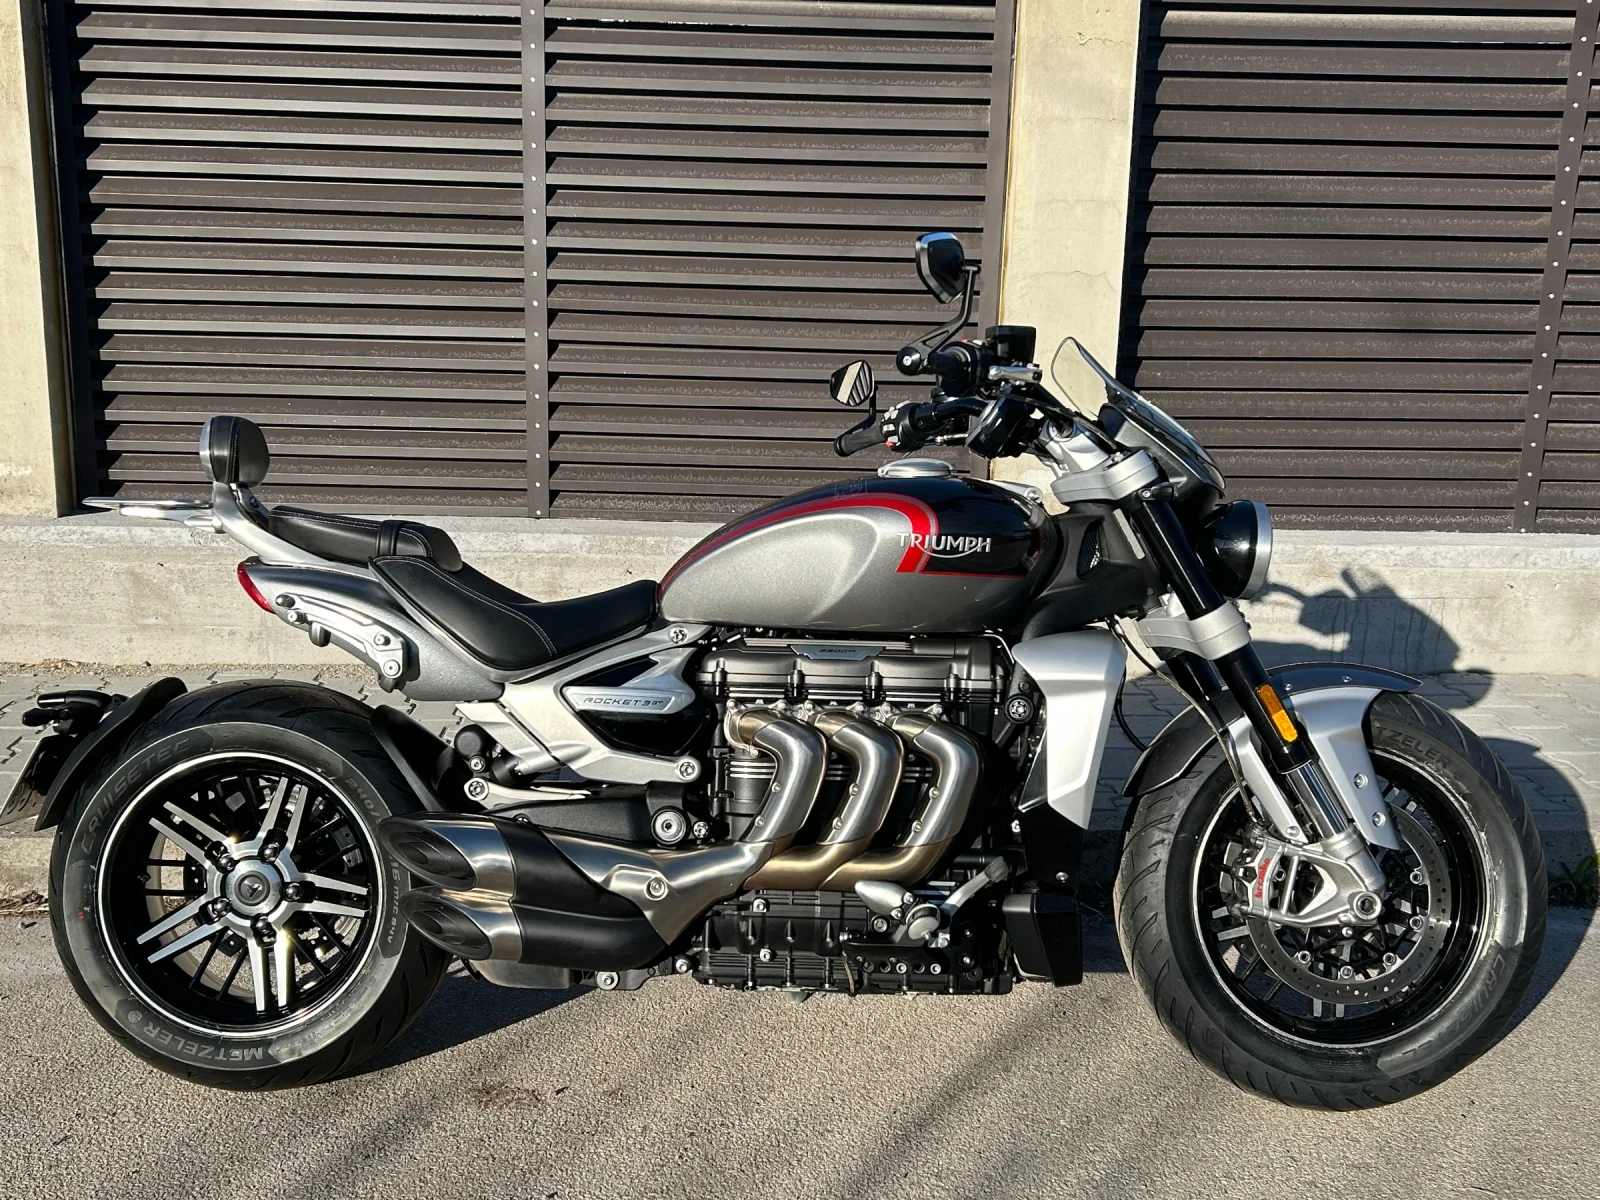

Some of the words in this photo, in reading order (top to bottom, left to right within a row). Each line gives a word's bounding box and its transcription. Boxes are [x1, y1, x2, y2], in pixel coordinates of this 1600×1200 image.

[897, 532, 992, 557] TRIUMPH
[1376, 726, 1450, 770] TZELER
[80, 737, 191, 856] CRUISETEC
[143, 1020, 264, 1062] METZELER
